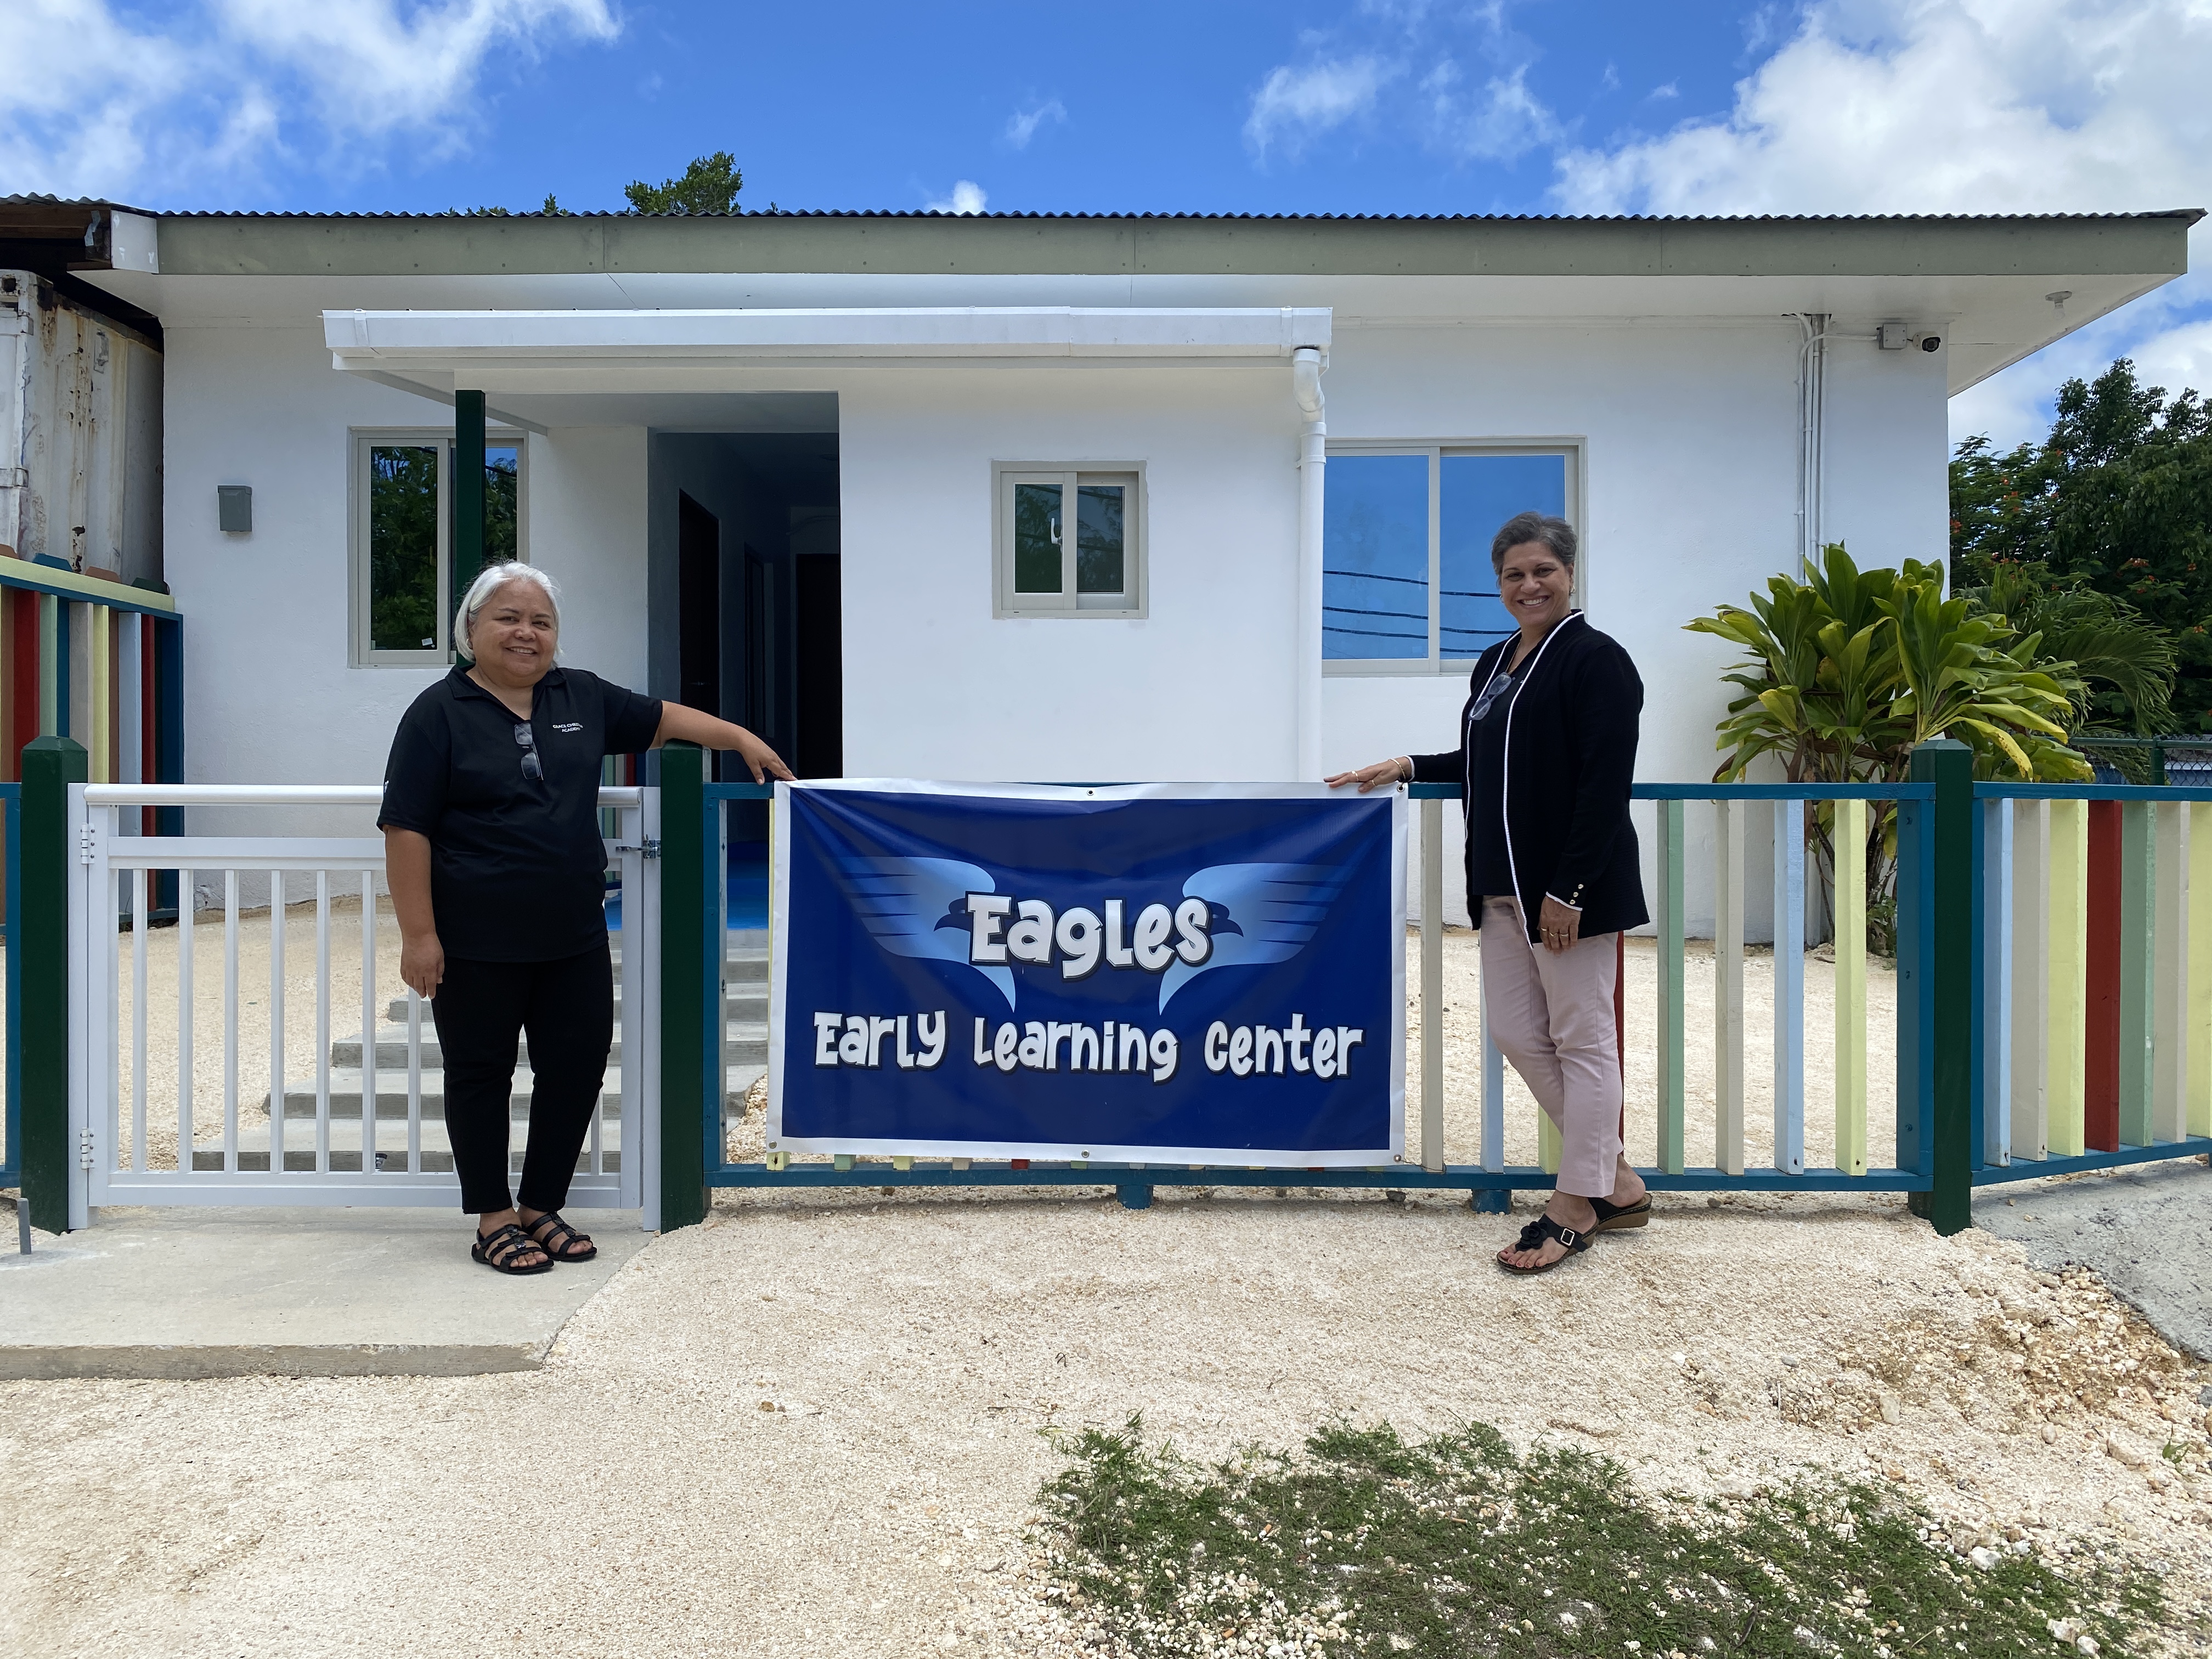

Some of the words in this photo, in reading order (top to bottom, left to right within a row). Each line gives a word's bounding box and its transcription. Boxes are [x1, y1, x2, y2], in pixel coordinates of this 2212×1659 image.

[967, 893, 1211, 979] Eagles
[813, 1010, 946, 1069] Early
[973, 1017, 1178, 1083] Learning
[1204, 1013, 1364, 1079] Center
